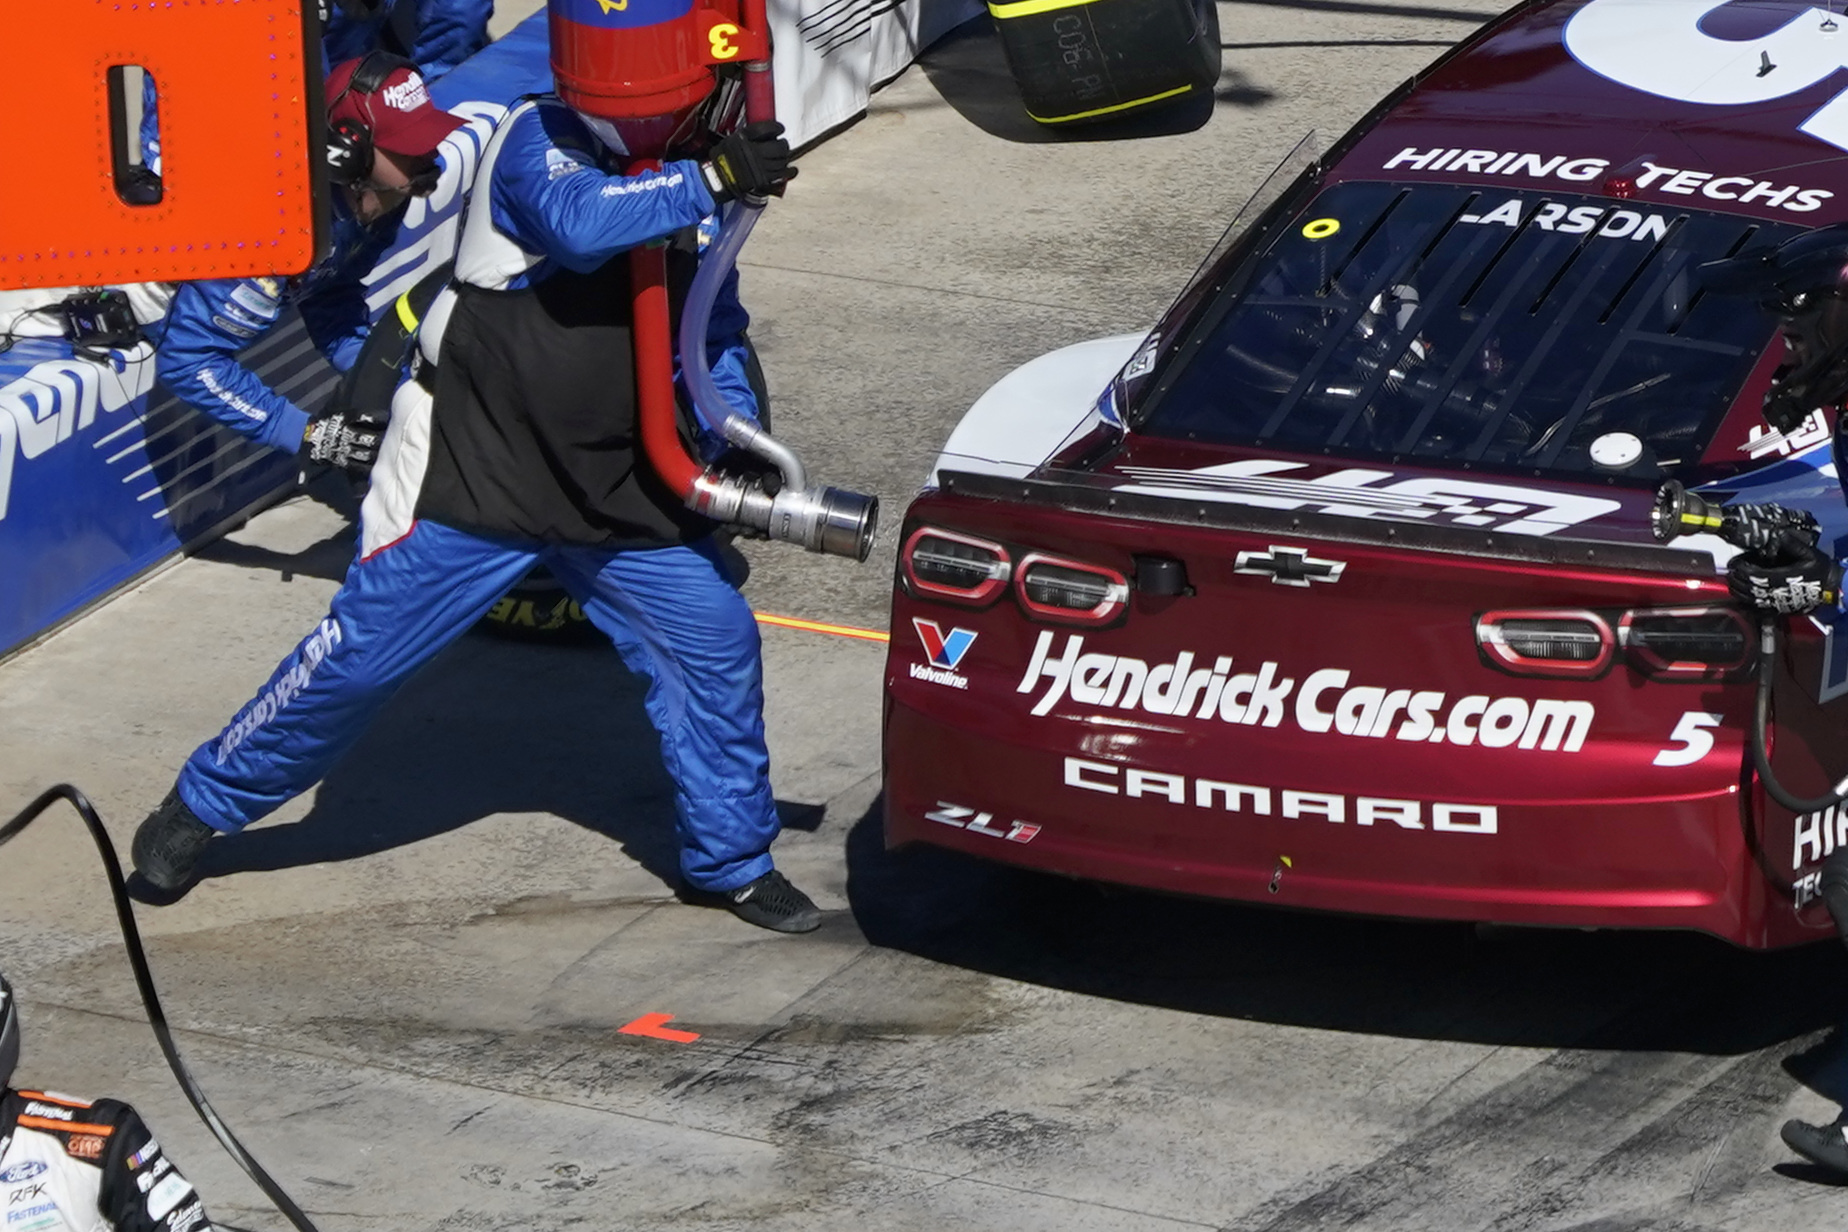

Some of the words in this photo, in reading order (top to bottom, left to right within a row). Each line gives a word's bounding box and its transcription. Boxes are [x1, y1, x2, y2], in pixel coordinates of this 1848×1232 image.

[1382, 147, 1611, 181] HIRING
[1635, 162, 1835, 212] TECHS
[909, 662, 969, 690] Valvoline
[1652, 711, 1725, 767] 5
[1064, 756, 1498, 835] CAMARO
[924, 799, 1043, 845] ZL1
[1792, 871, 1823, 910] TEC
